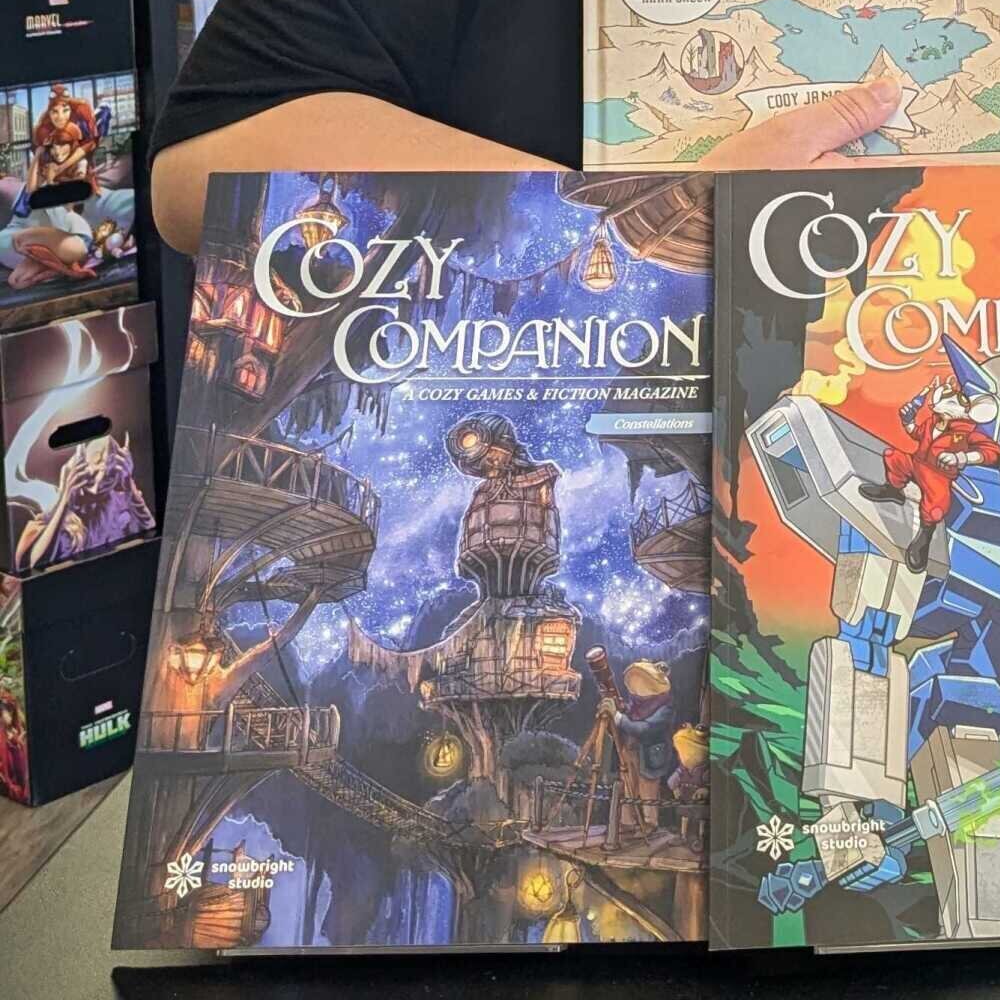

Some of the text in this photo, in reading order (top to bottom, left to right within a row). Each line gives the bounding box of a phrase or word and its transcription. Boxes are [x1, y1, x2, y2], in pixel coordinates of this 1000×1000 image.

[767, 89, 842, 110] CODY JAM
[749, 191, 972, 300] COZY
[253, 217, 465, 318] COZY
[333, 304, 709, 385] COMPANION
[403, 386, 700, 401] A COZY GAMES & FICTION MAGAZINE
[613, 417, 695, 430] Constellations
[79, 712, 131, 748] HULK
[802, 819, 886, 834] snowbright
[821, 836, 868, 850] studio
[211, 859, 295, 875] snowbright
[228, 876, 275, 889] studio
